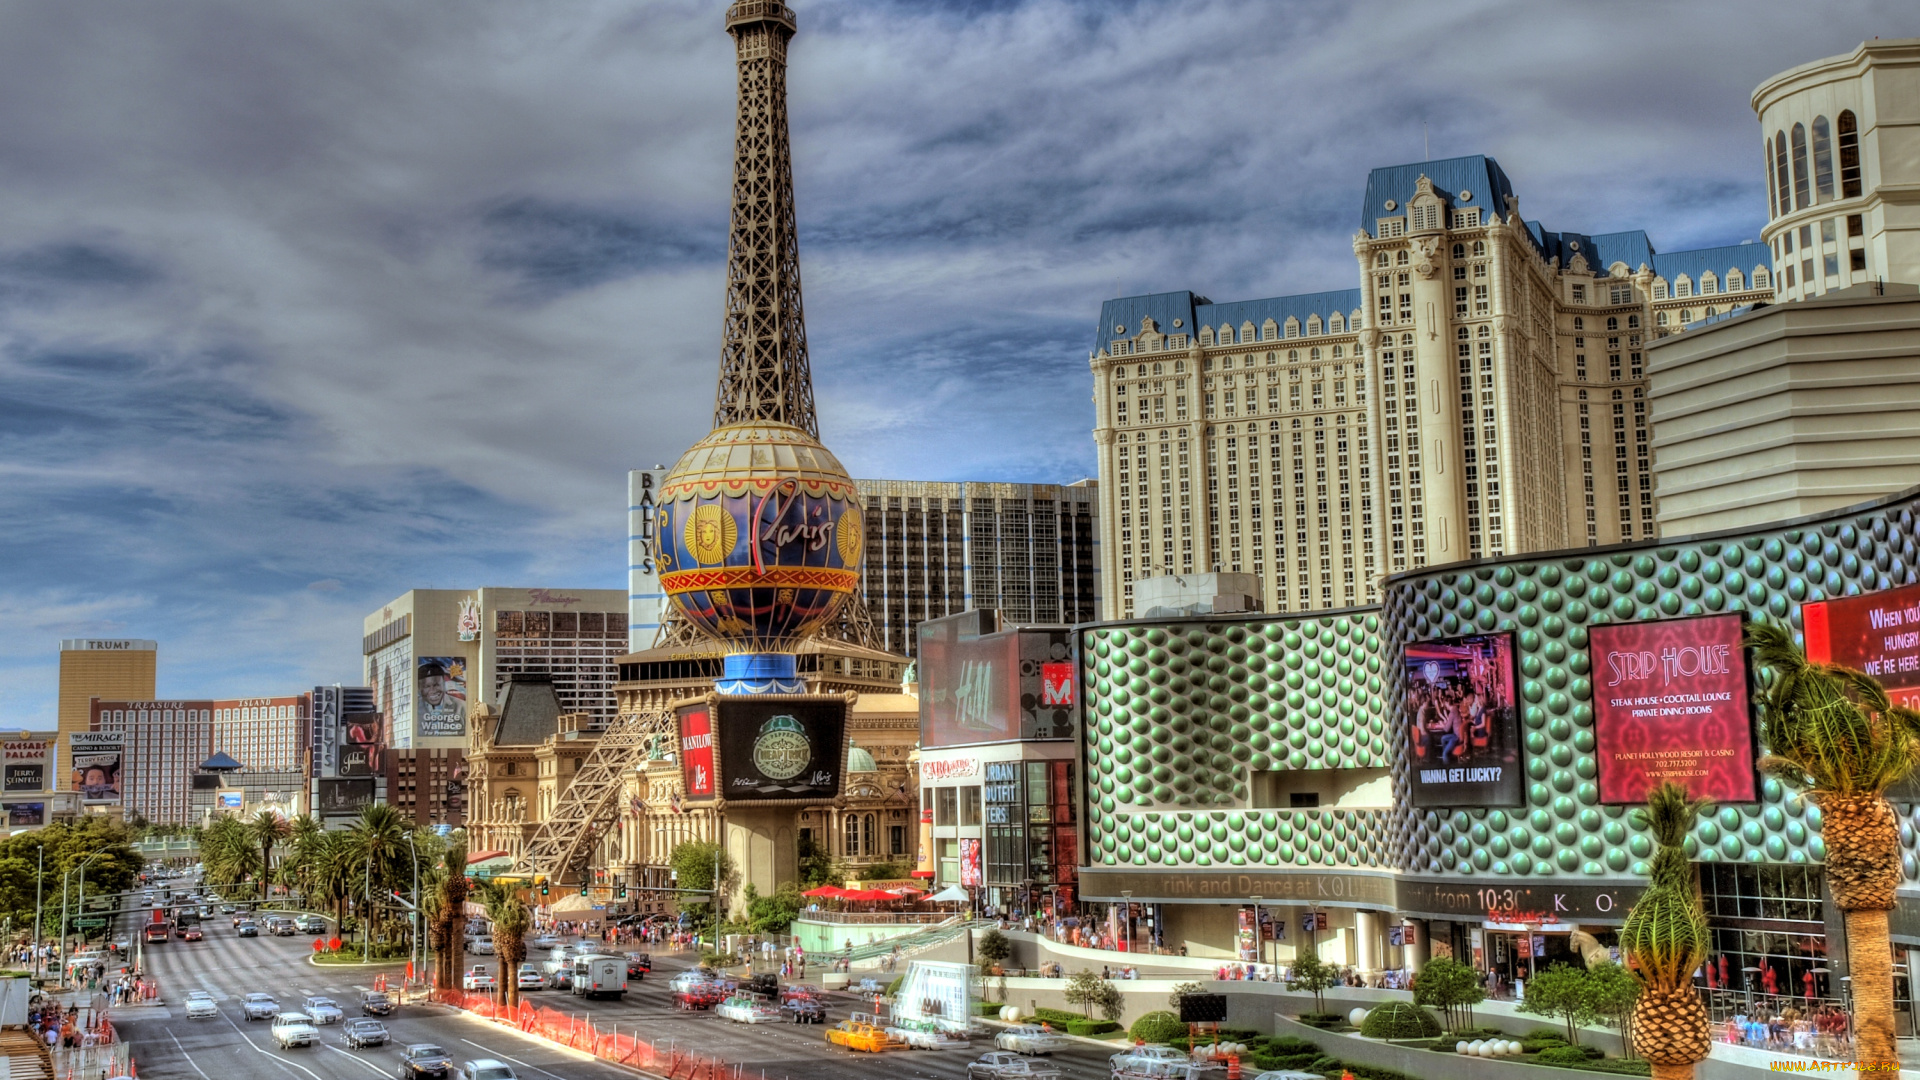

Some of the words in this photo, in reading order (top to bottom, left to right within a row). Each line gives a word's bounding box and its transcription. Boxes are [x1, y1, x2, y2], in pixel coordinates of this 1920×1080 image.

[641, 473, 653, 575] BALLYS
[753, 477, 834, 575] Paris
[89, 641, 130, 649] TRUMP
[1884, 631, 1919, 651] HUNGRY
[1608, 651, 1657, 686] STRIP
[1662, 645, 1730, 686] HOUSE
[1865, 655, 1896, 676] WE'RE
[1898, 655, 1919, 671] HERE
[239, 699, 271, 707] ISLAND
[1611, 699, 1632, 707] STEAK
[1634, 696, 1658, 705] HOUSE
[1663, 694, 1700, 703] COCKTAIL
[1703, 692, 1731, 701] LOUNGE
[423, 713, 460, 723] George
[1632, 708, 1658, 717] PRIVATE
[1686, 705, 1712, 714] ROOMS
[323, 690, 334, 767] BALLYS
[422, 722, 462, 730] Wallace
[4, 742, 46, 750] CAESARS
[76, 734, 122, 742] MIRAGE
[683, 733, 711, 751] MANILOW
[1615, 752, 1638, 760] PLANET
[1639, 751, 1679, 759] HOLLYWOOD
[1681, 750, 1703, 758] RESORT
[1711, 749, 1734, 757] CASINO
[14, 769, 35, 777] JERRY
[1420, 769, 1447, 784] WANNA
[1449, 768, 1465, 783] GET
[1466, 767, 1502, 782] LUCKY?
[1163, 876, 1193, 892] rink
[1200, 877, 1231, 894] and
[1238, 876, 1292, 894] Dance
[1435, 886, 1471, 909] from
